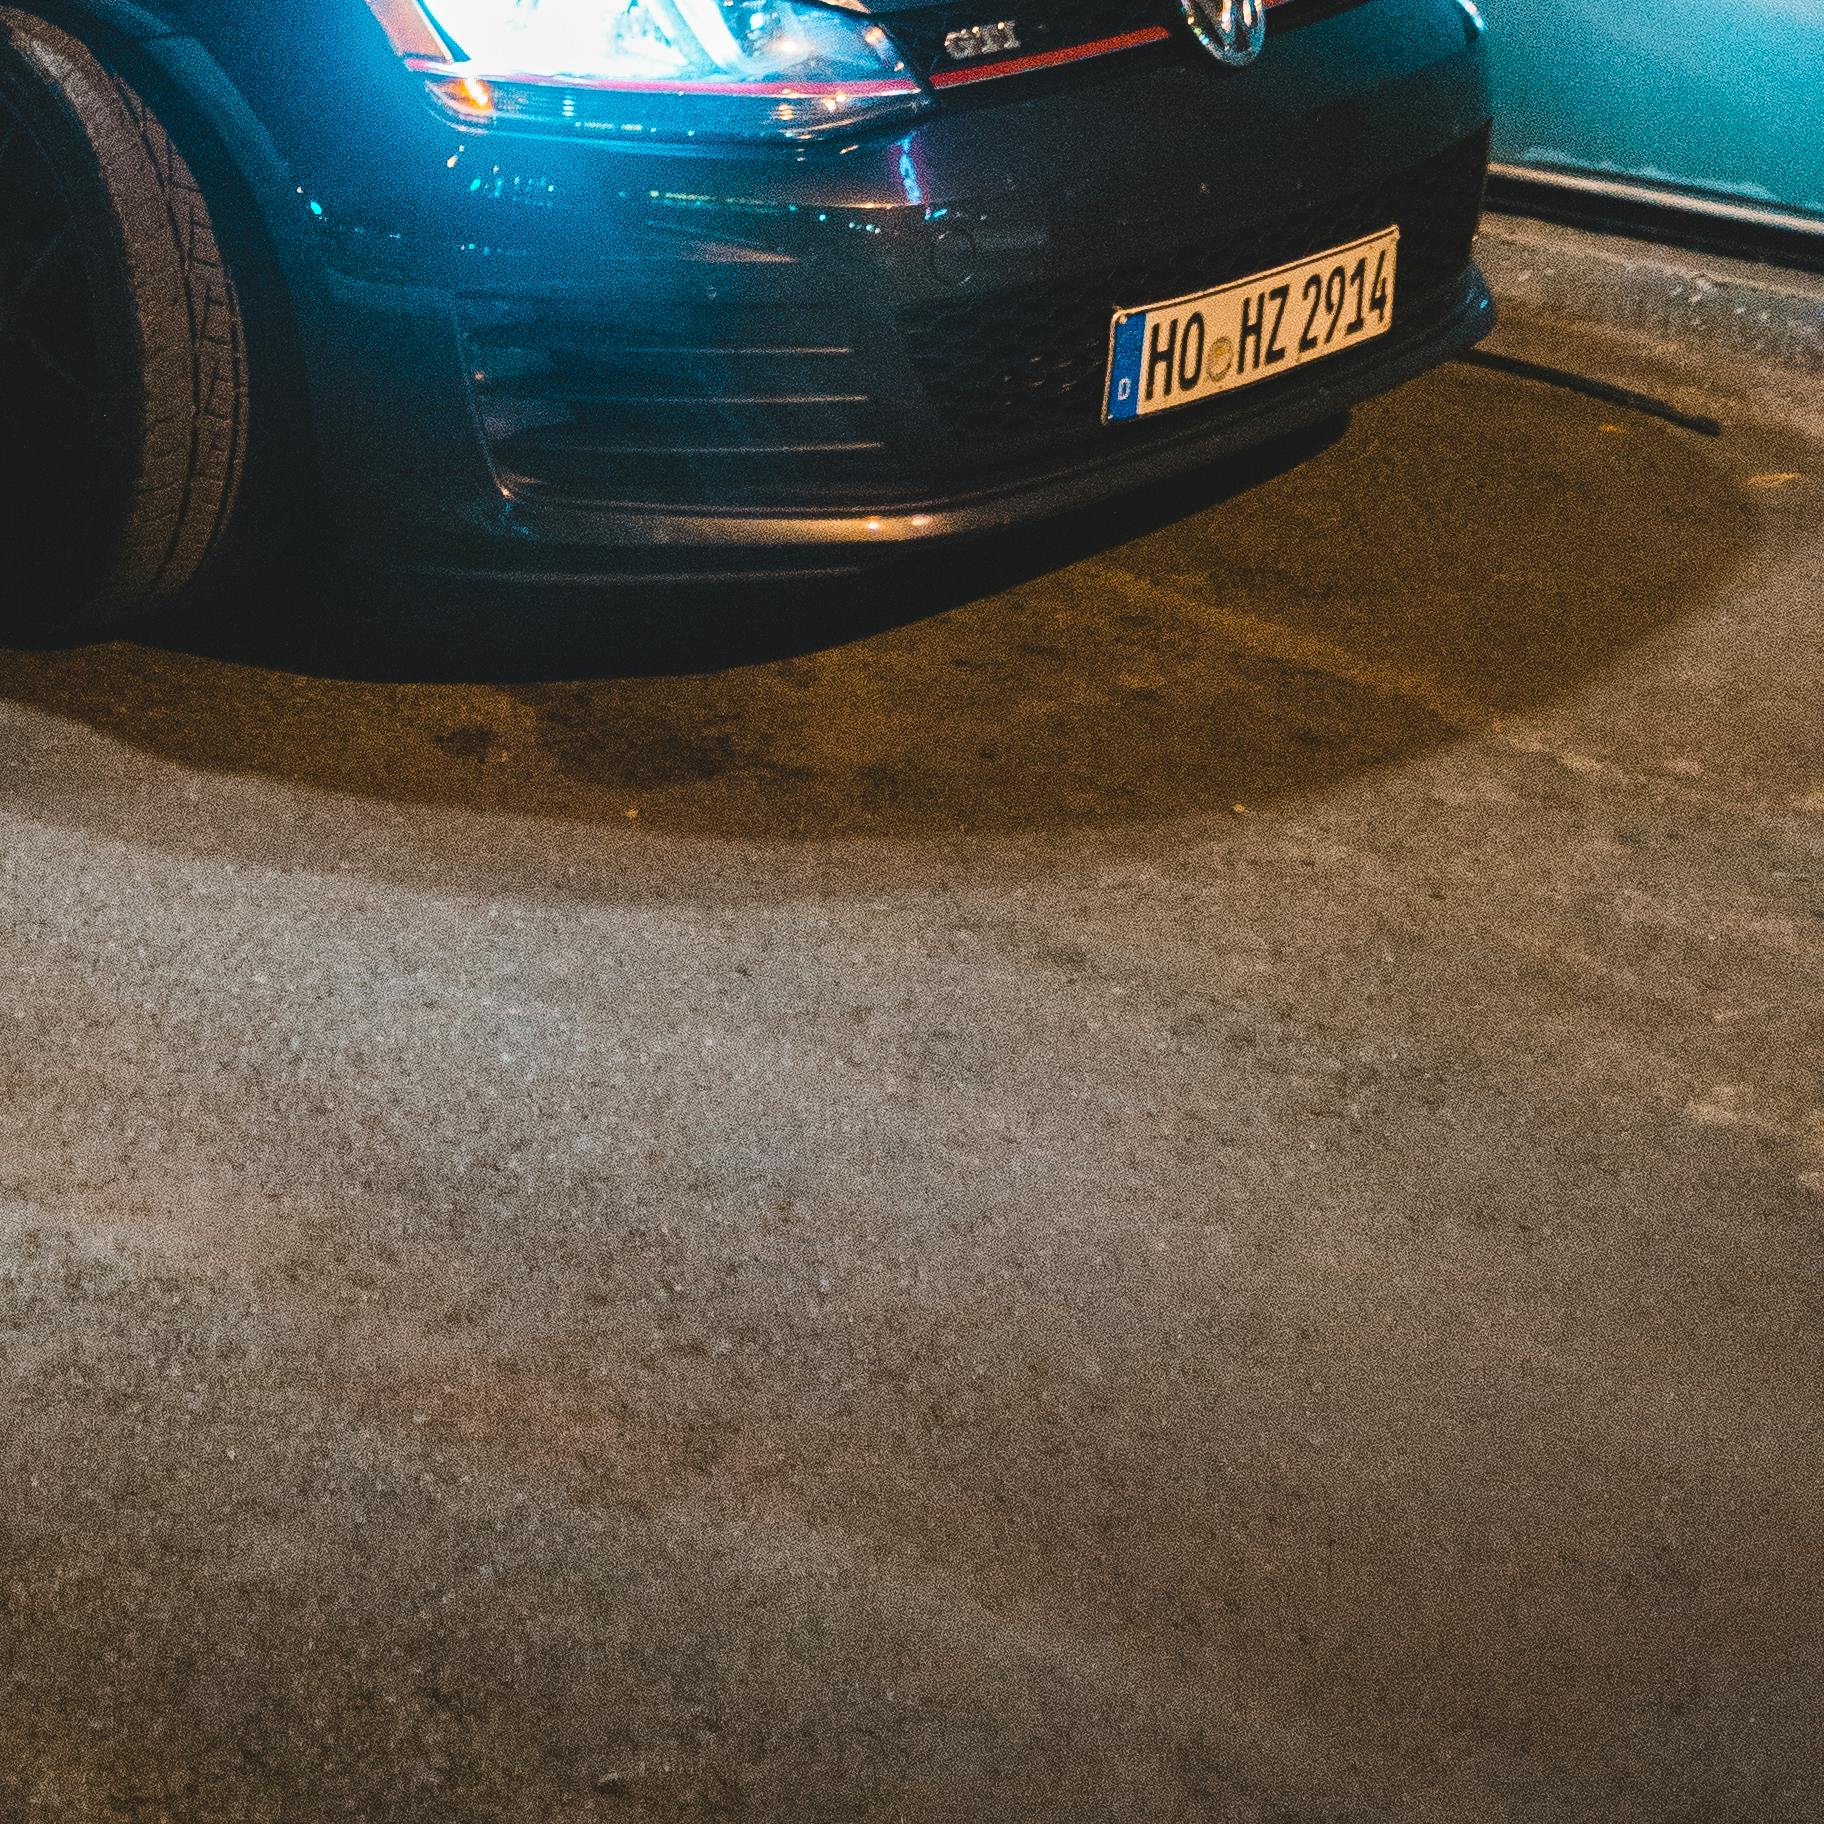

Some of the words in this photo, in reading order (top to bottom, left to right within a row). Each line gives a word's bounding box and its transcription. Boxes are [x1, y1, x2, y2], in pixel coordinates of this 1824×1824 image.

[1116, 377, 1131, 401] D
[1144, 311, 1205, 401] HO
[1237, 285, 1292, 375] HZ
[1300, 249, 1392, 351] 2914
